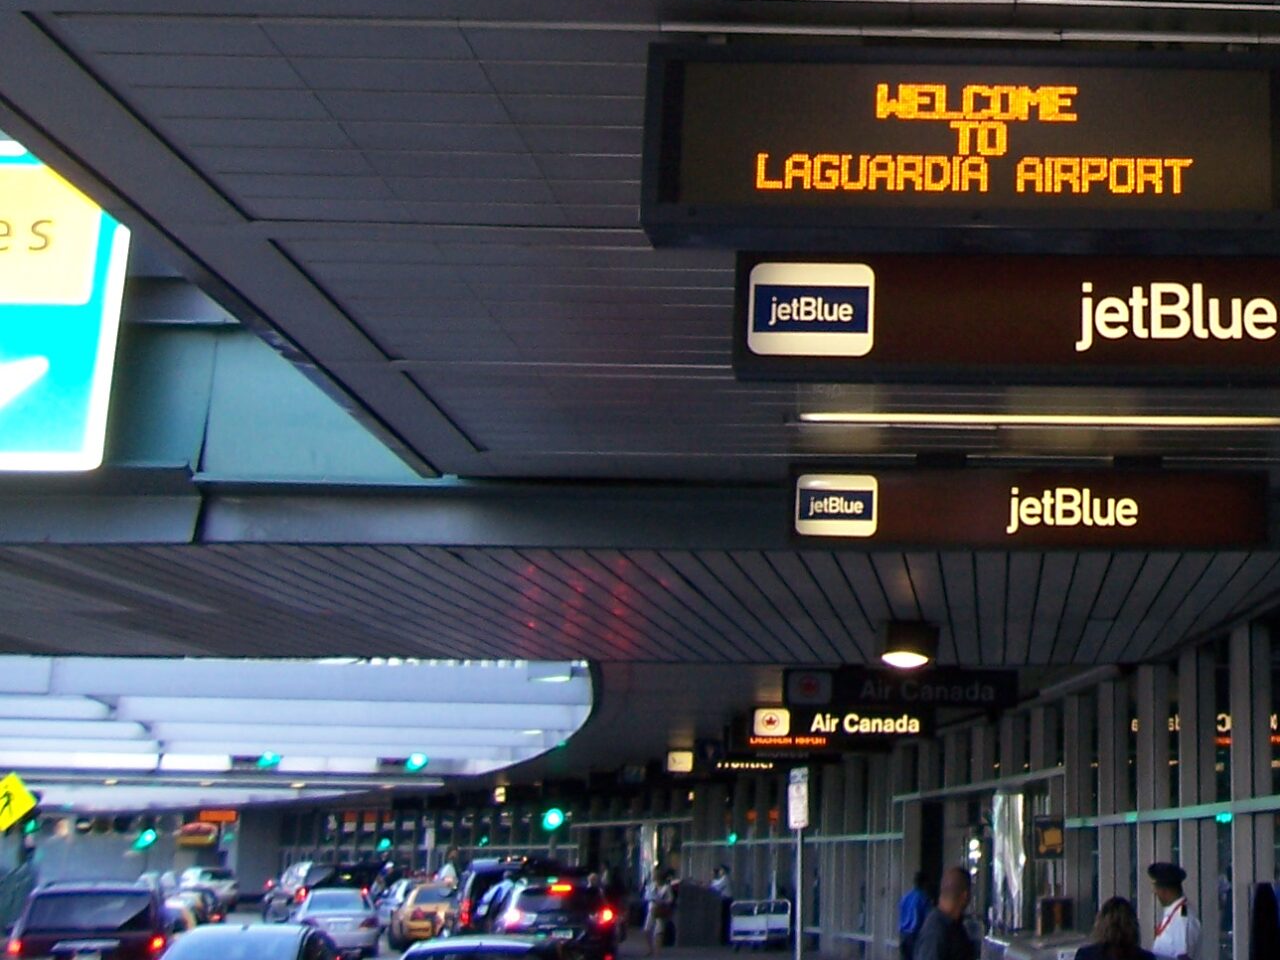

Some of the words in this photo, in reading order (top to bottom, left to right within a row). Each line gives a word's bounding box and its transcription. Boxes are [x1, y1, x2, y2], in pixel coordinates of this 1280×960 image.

[875, 83, 1078, 123] WELCOME
[950, 121, 1008, 157] TO
[755, 152, 989, 193] LAGUARDIA
[1015, 156, 1194, 195] AIRPORT
[768, 296, 854, 326] jetBlue
[1075, 282, 1278, 352] jetBlue
[808, 496, 864, 516] jetBlue
[1006, 487, 1138, 534] jetBlue
[860, 680, 891, 702] Air
[899, 680, 995, 702] Canada
[810, 713, 838, 733] Air
[843, 713, 920, 734] Canada
